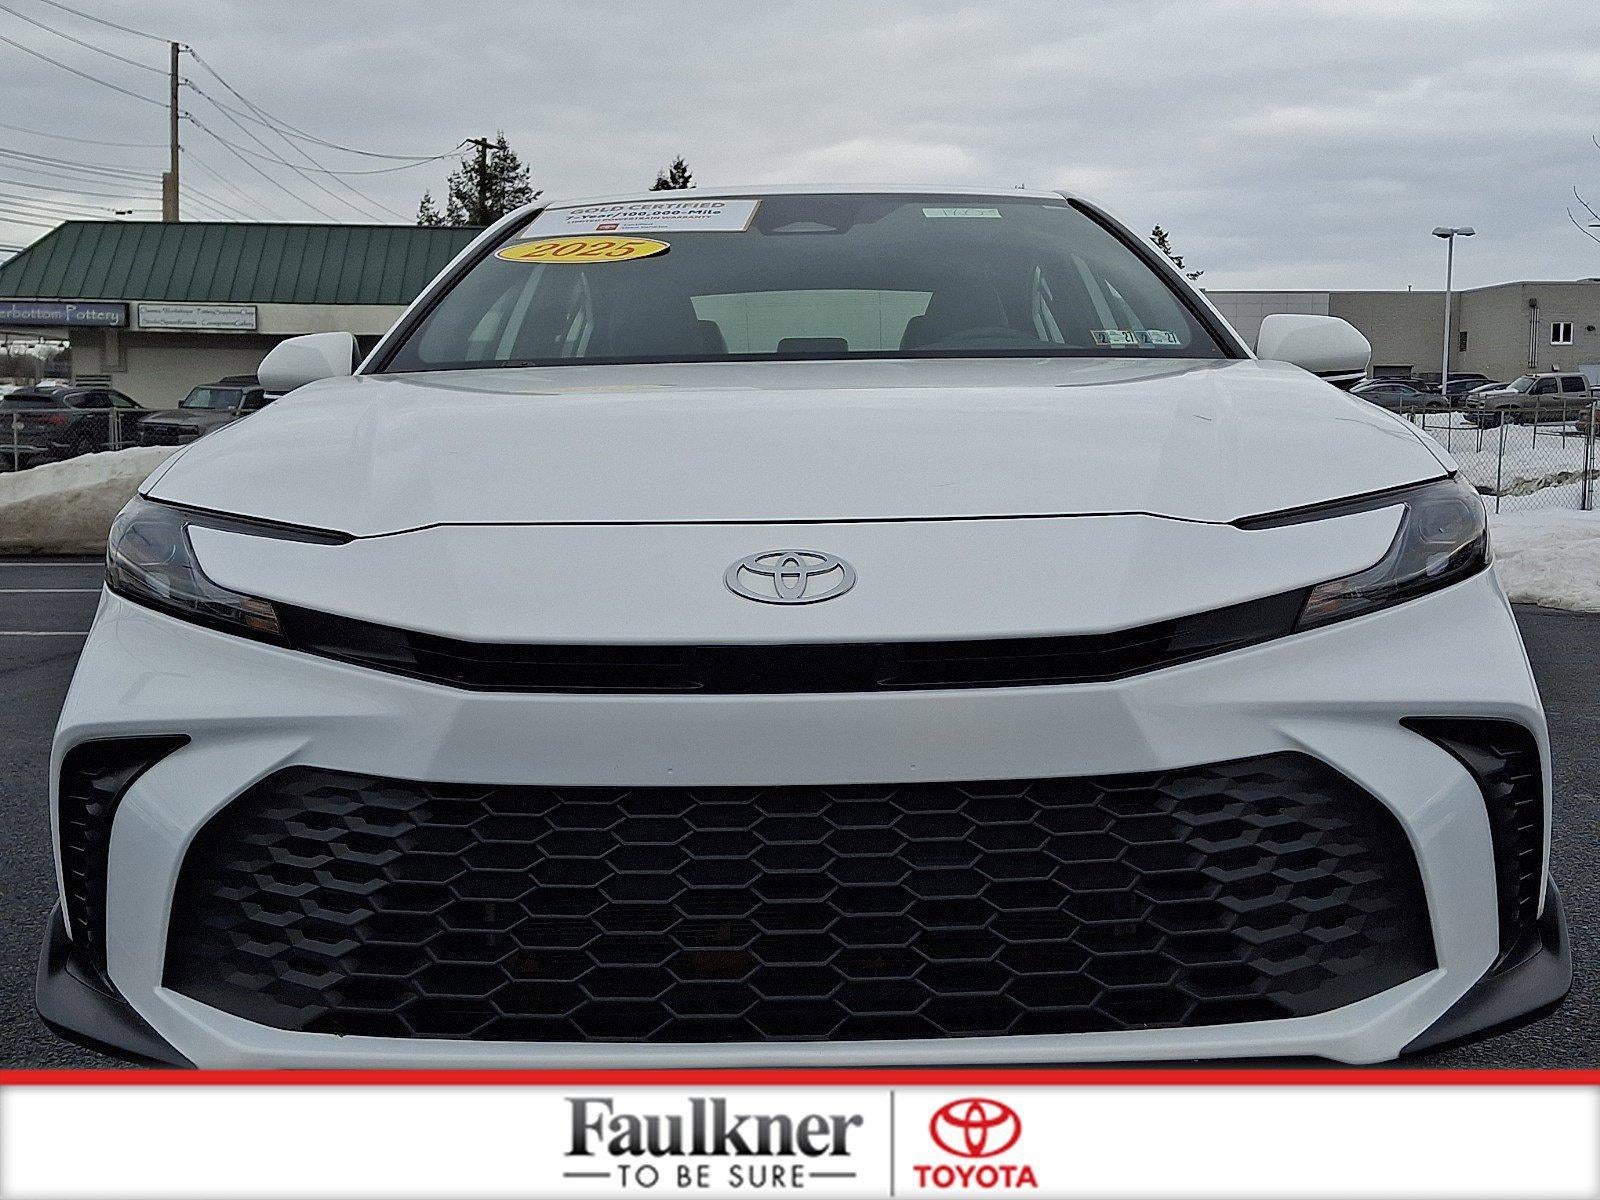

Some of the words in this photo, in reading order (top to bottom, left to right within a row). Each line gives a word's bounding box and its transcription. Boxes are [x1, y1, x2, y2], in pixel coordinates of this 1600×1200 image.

[570, 206, 624, 215] GOLD
[628, 201, 726, 210] CERTIFIED
[519, 241, 647, 259] 2025
[66, 304, 119, 326] Pottery
